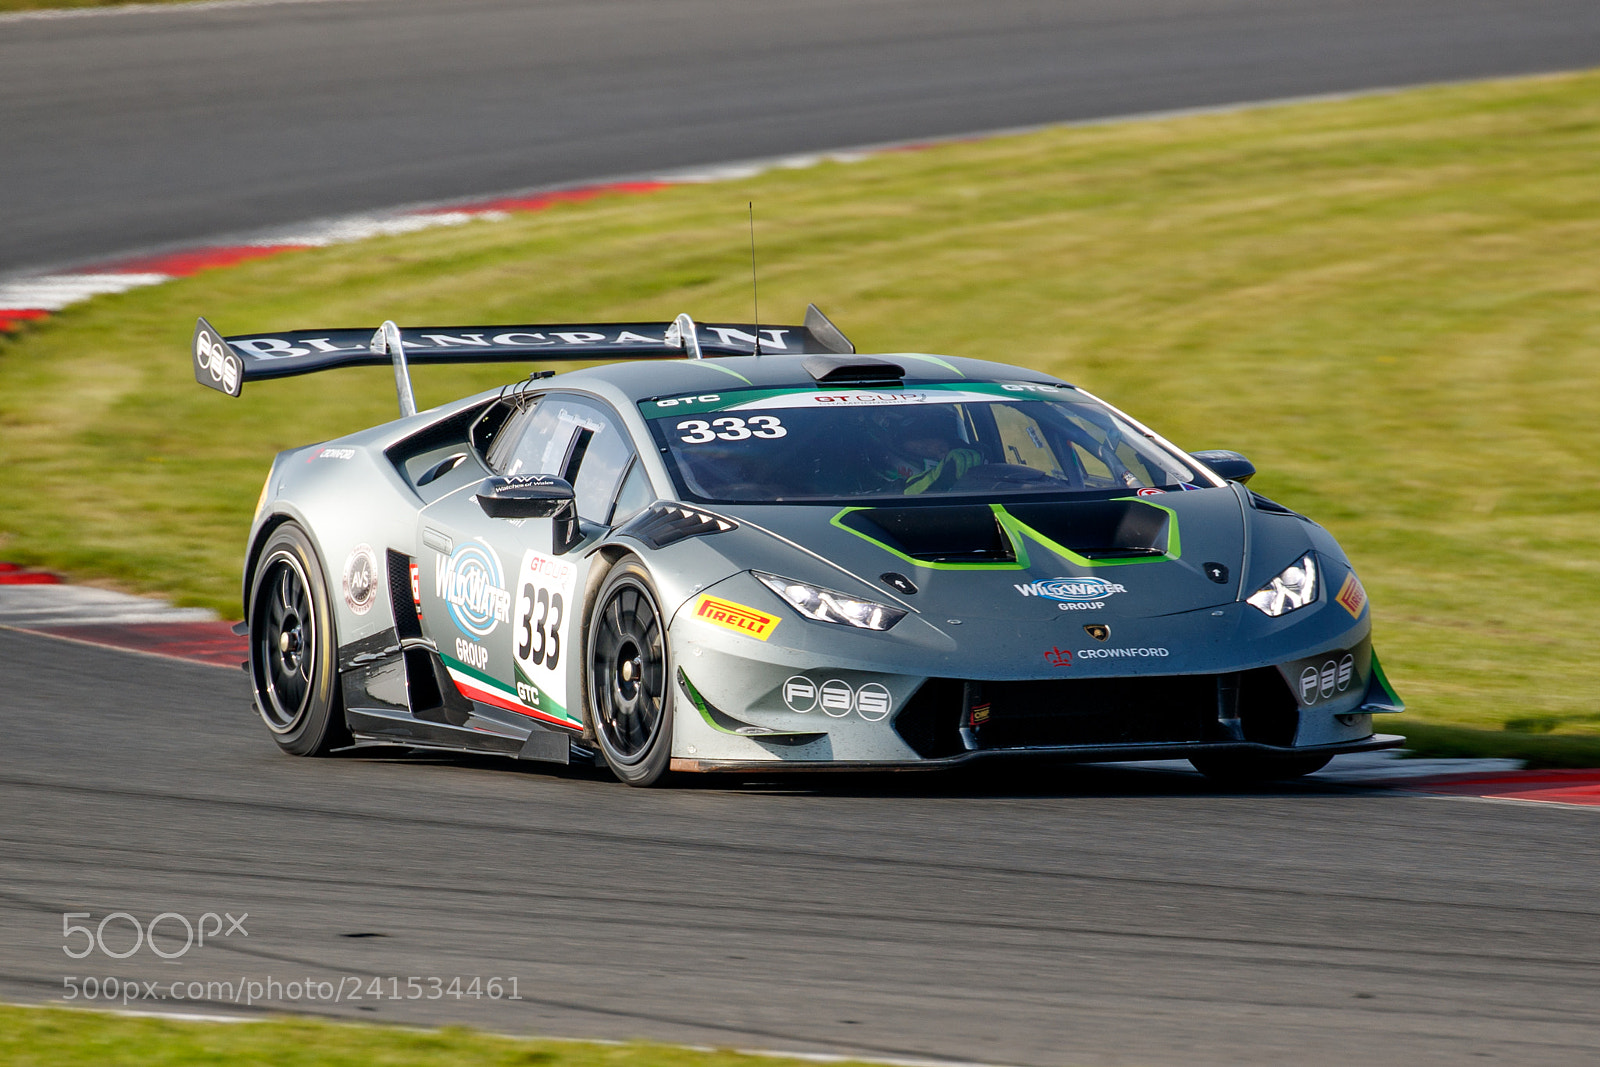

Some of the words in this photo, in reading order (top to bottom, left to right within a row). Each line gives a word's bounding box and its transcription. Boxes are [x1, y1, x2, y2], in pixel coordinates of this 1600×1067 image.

[1001, 384, 1059, 393] GTC
[656, 395, 721, 408] GTC
[676, 415, 788, 444] 333
[495, 483, 523, 493] Watches
[351, 561, 369, 589] AVS
[697, 599, 771, 634] PIRELLI
[1058, 601, 1105, 611] GROUP
[518, 582, 563, 671] 333
[455, 636, 489, 671] GROUP
[1077, 647, 1170, 660] CROWNFORD
[516, 681, 540, 706] GTC
